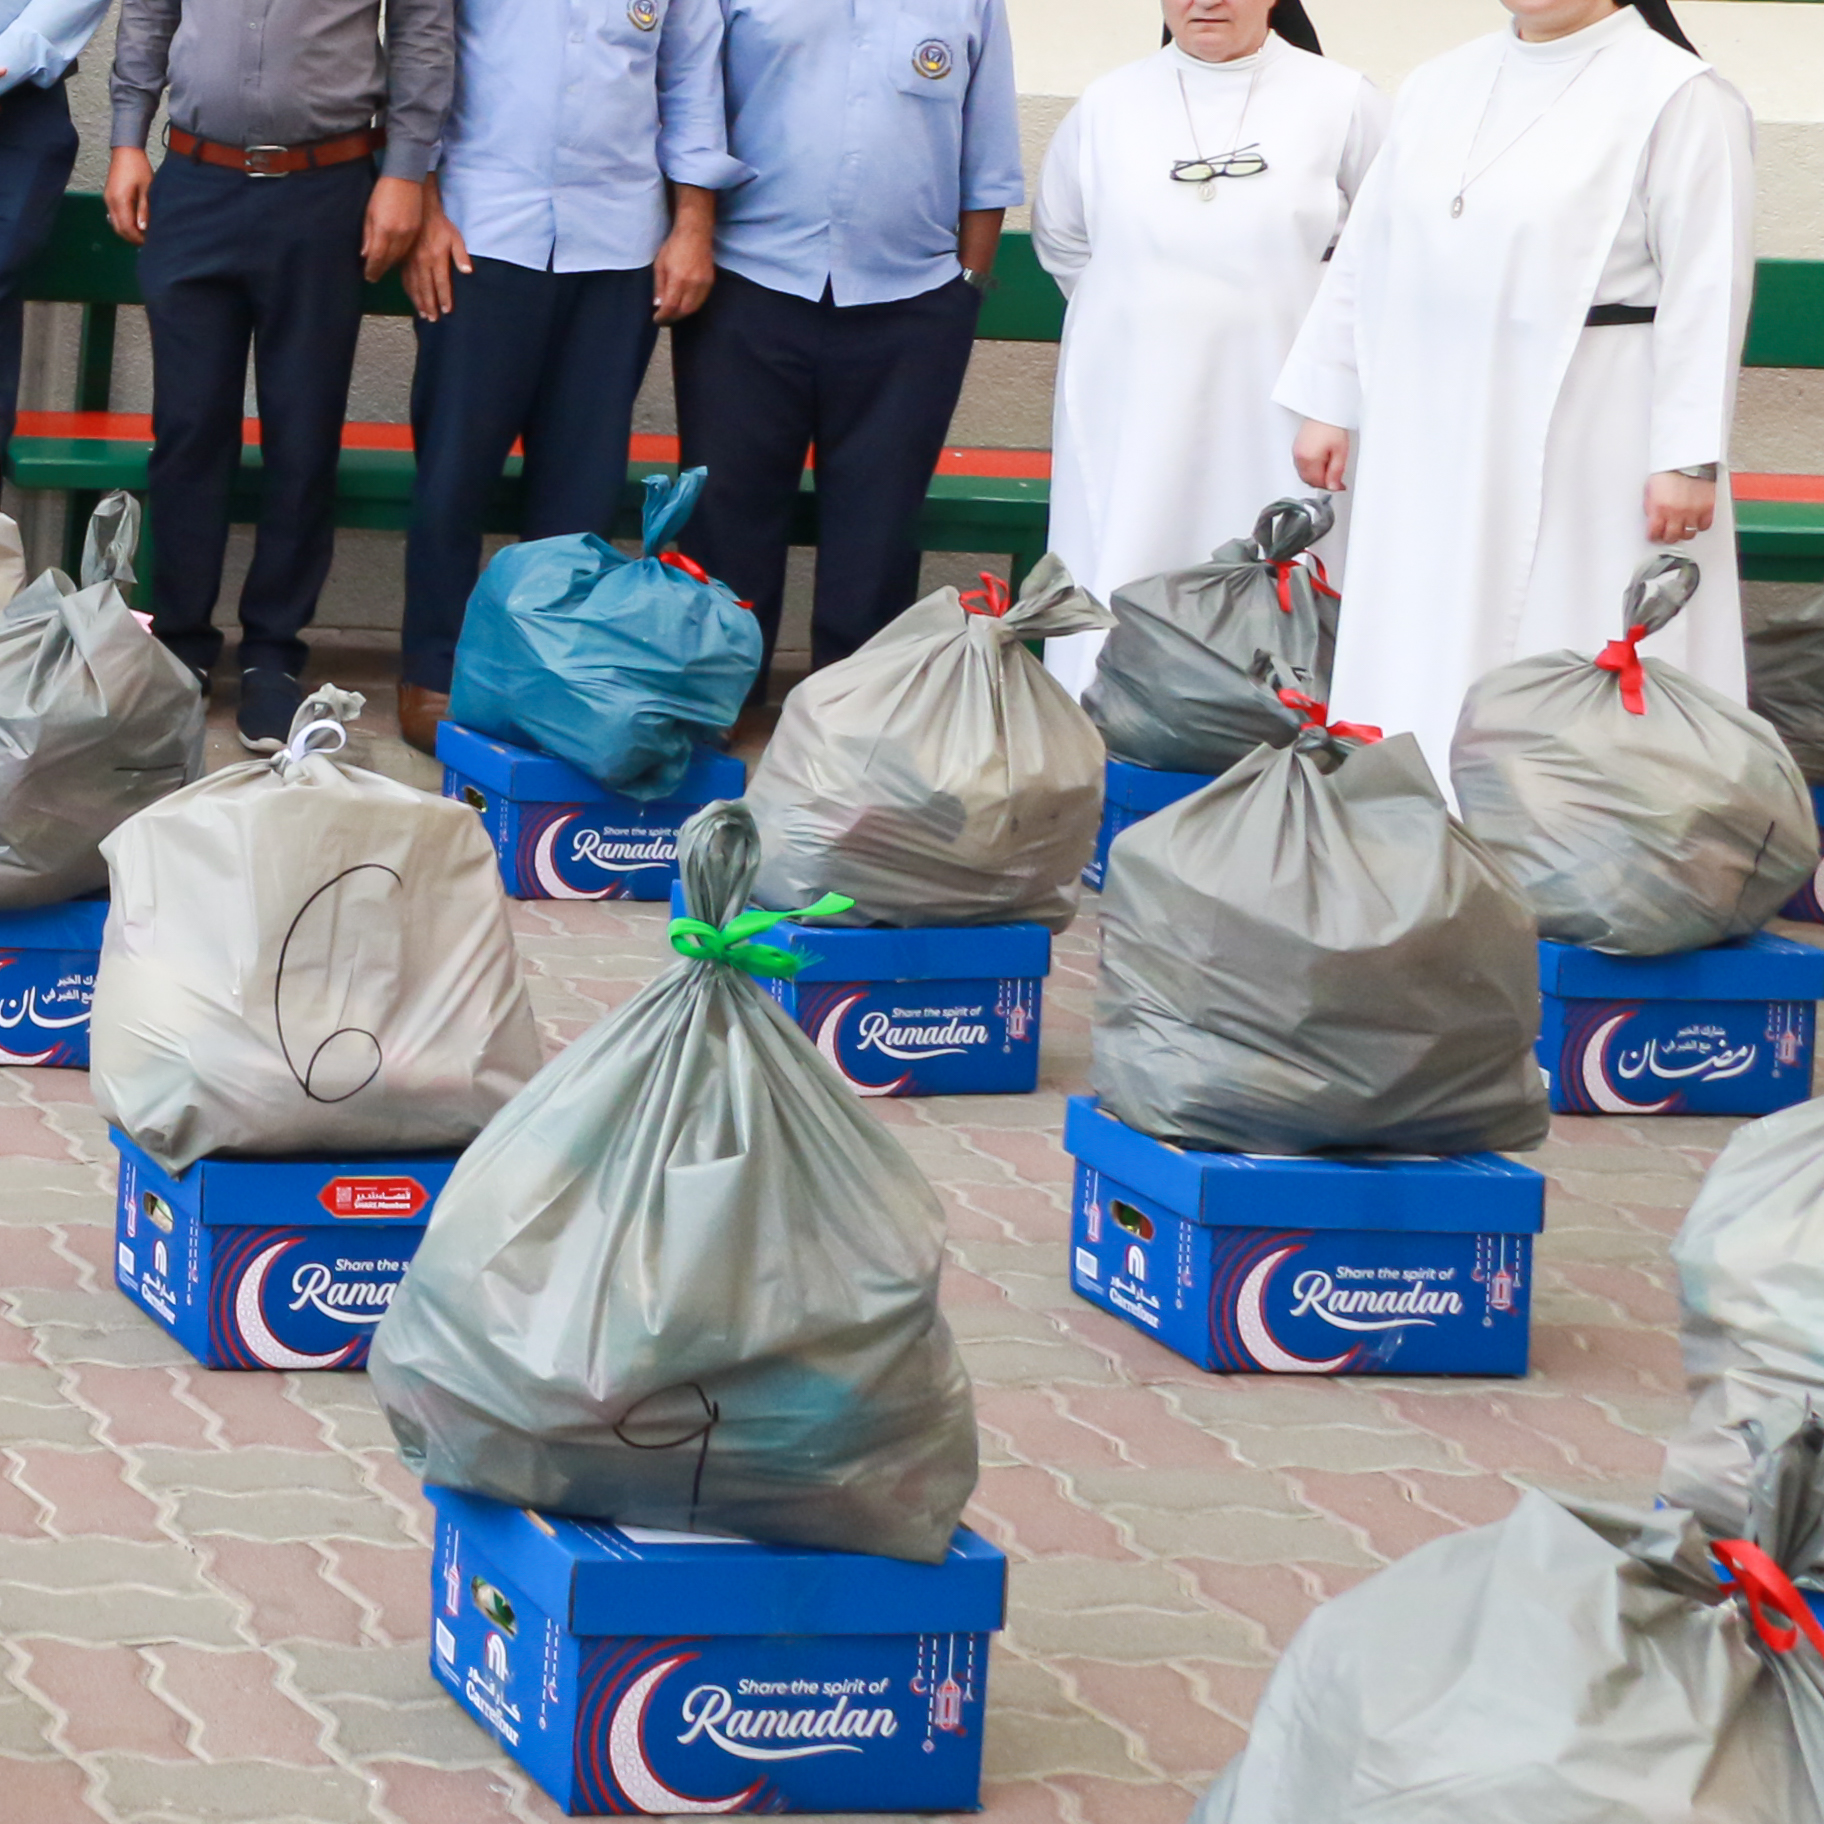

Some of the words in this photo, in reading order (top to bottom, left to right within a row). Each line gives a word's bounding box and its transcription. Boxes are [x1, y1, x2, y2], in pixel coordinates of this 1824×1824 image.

[856, 1011, 988, 1060] Ramadan
[1618, 1038, 1756, 1082] رمضان
[335, 1258, 374, 1271] Share
[377, 1259, 399, 1271] the
[1335, 1266, 1374, 1280] Share
[1377, 1267, 1400, 1280] the
[1402, 1267, 1437, 1282] spirit
[1438, 1267, 1455, 1280] of
[288, 1263, 397, 1324] Rama
[1289, 1270, 1463, 1331] Ramadan
[737, 1679, 787, 1695] Share
[791, 1679, 819, 1694] the
[821, 1679, 866, 1697] spirit
[868, 1677, 890, 1694] of
[466, 1680, 519, 1746] Carrefour
[676, 1685, 898, 1760] Ramadan
